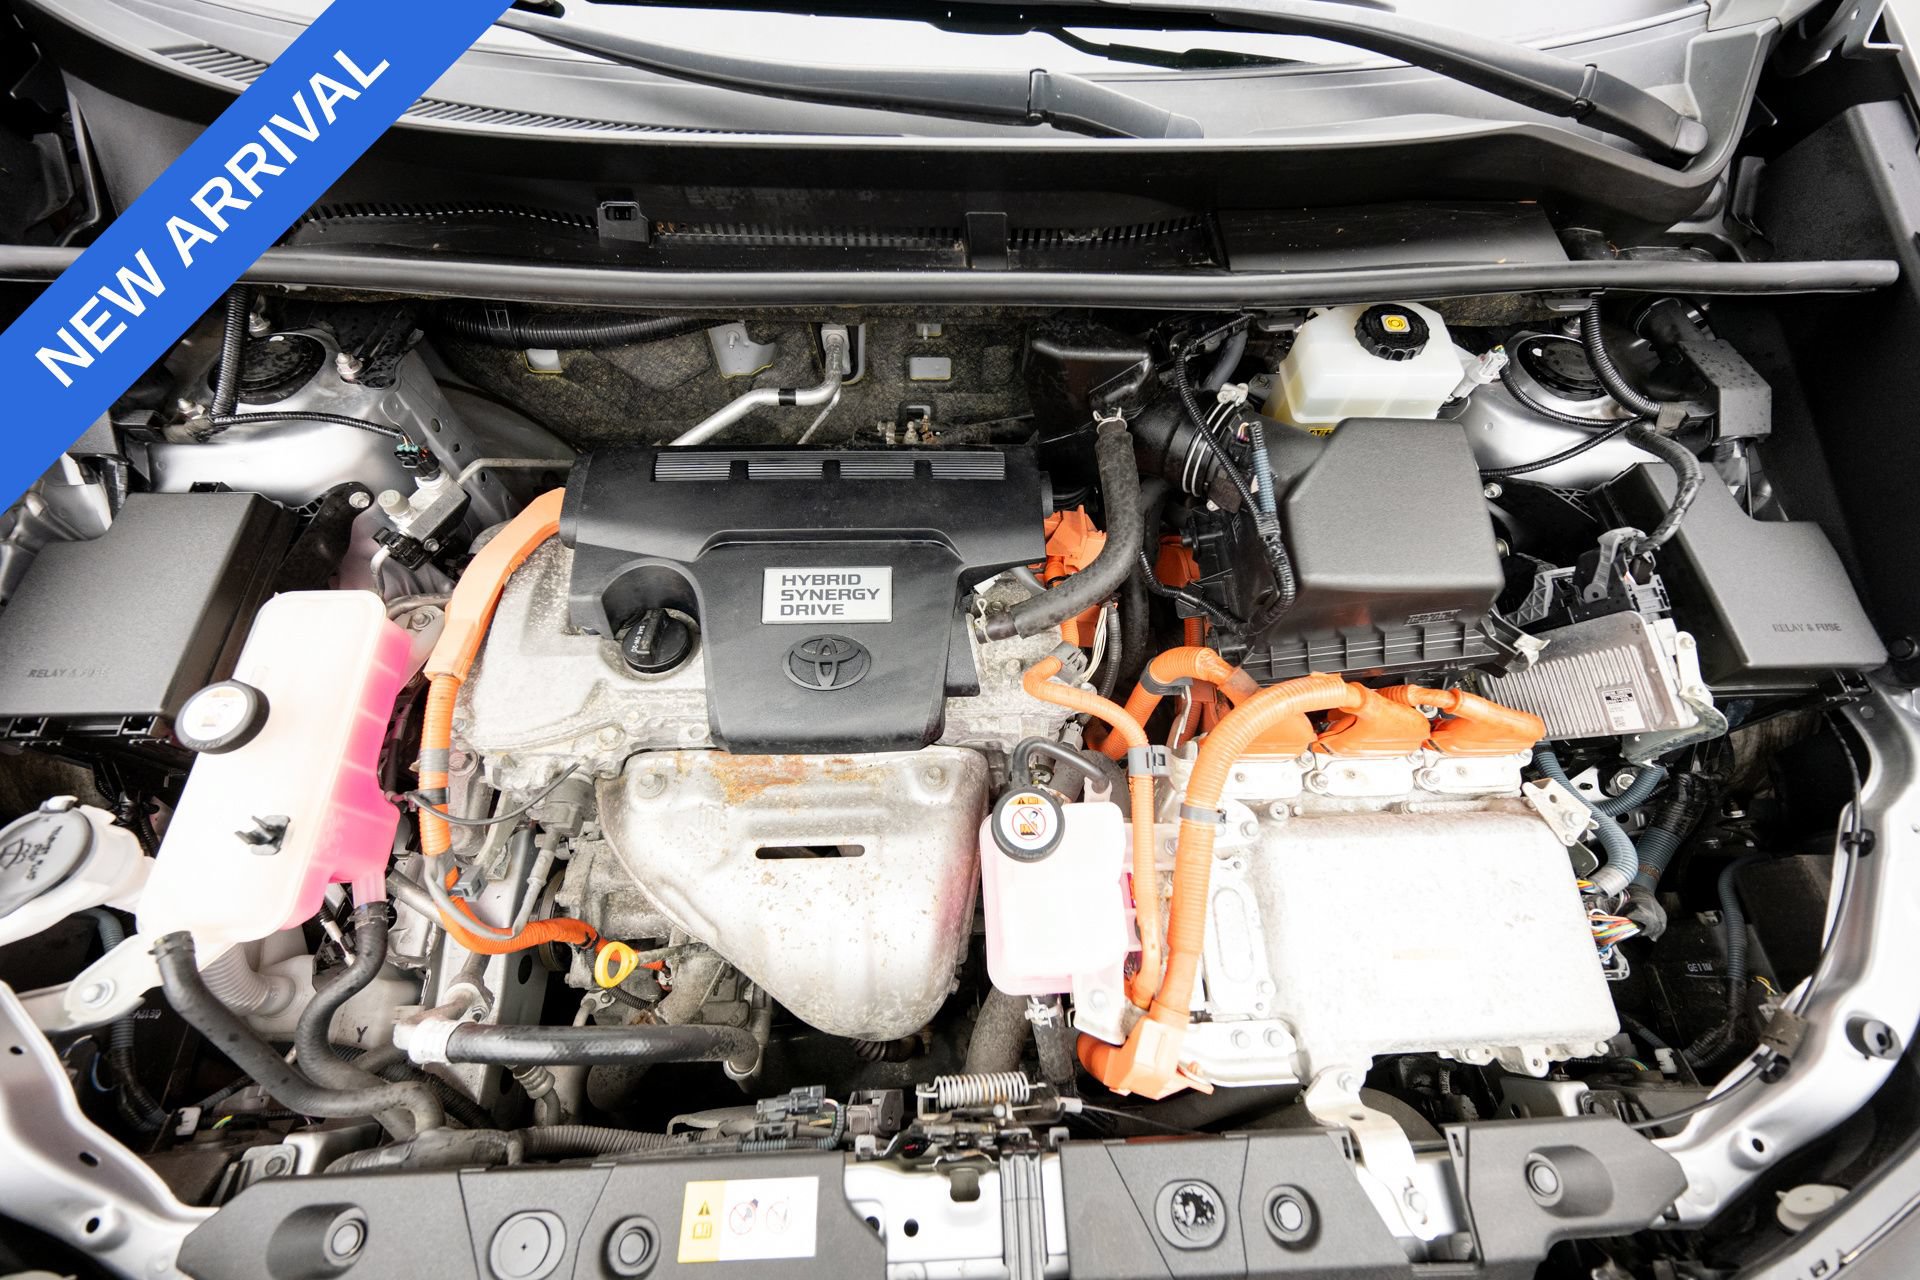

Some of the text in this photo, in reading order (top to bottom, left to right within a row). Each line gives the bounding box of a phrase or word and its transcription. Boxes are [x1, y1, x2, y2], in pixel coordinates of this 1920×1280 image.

[781, 573, 862, 587] HYBRID
[780, 588, 880, 601] SYNERGY
[780, 603, 845, 616] DRIVE
[1771, 623, 1804, 632] RELAY
[1815, 623, 1842, 632] FUSE
[27, 669, 68, 678] RELAY
